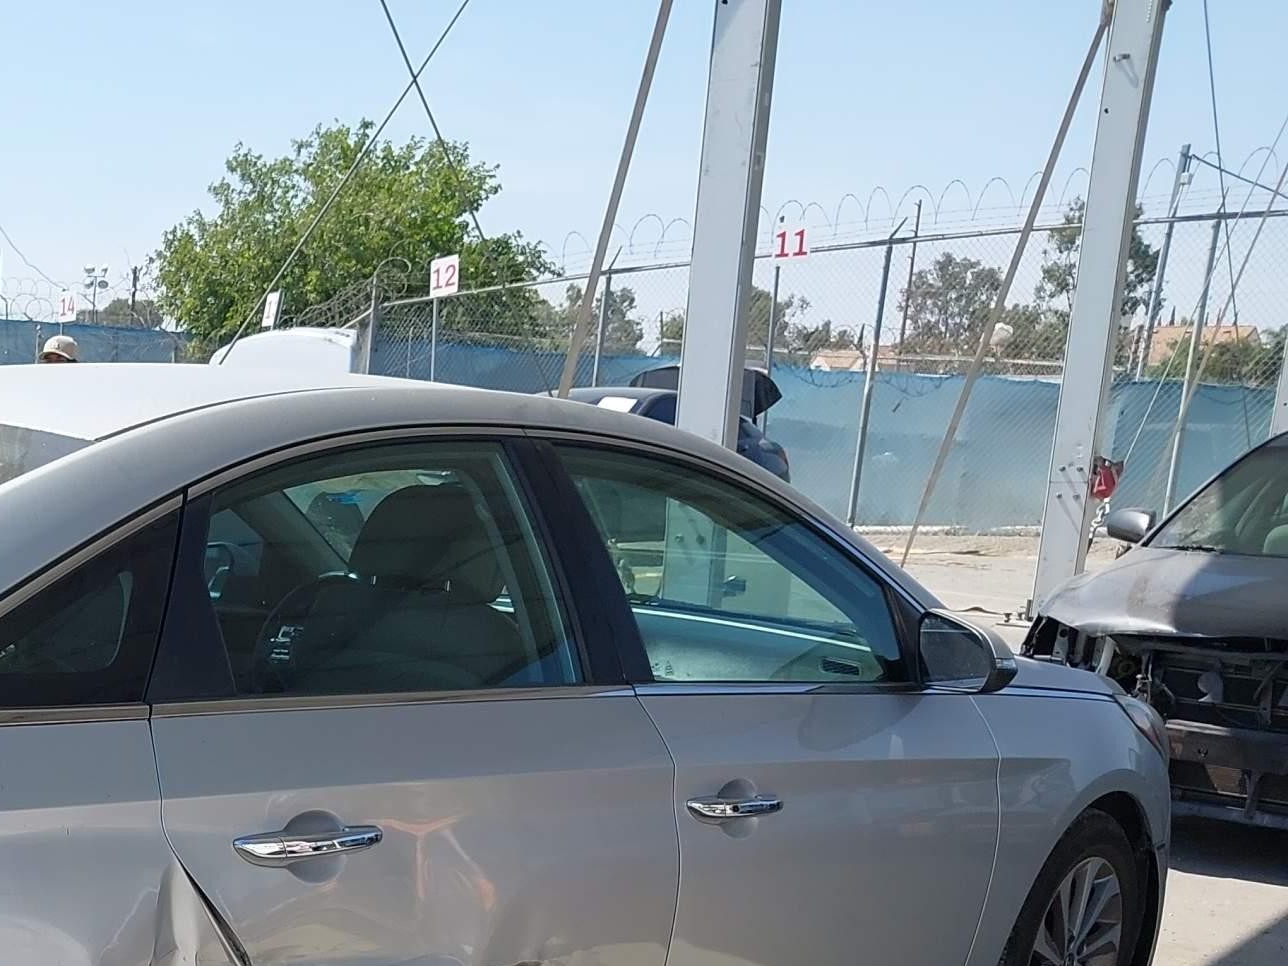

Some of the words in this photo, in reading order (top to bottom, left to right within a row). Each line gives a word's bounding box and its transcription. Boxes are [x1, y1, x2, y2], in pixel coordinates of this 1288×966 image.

[775, 229, 808, 258] 11
[432, 264, 457, 290] 12
[60, 296, 75, 317] 14
